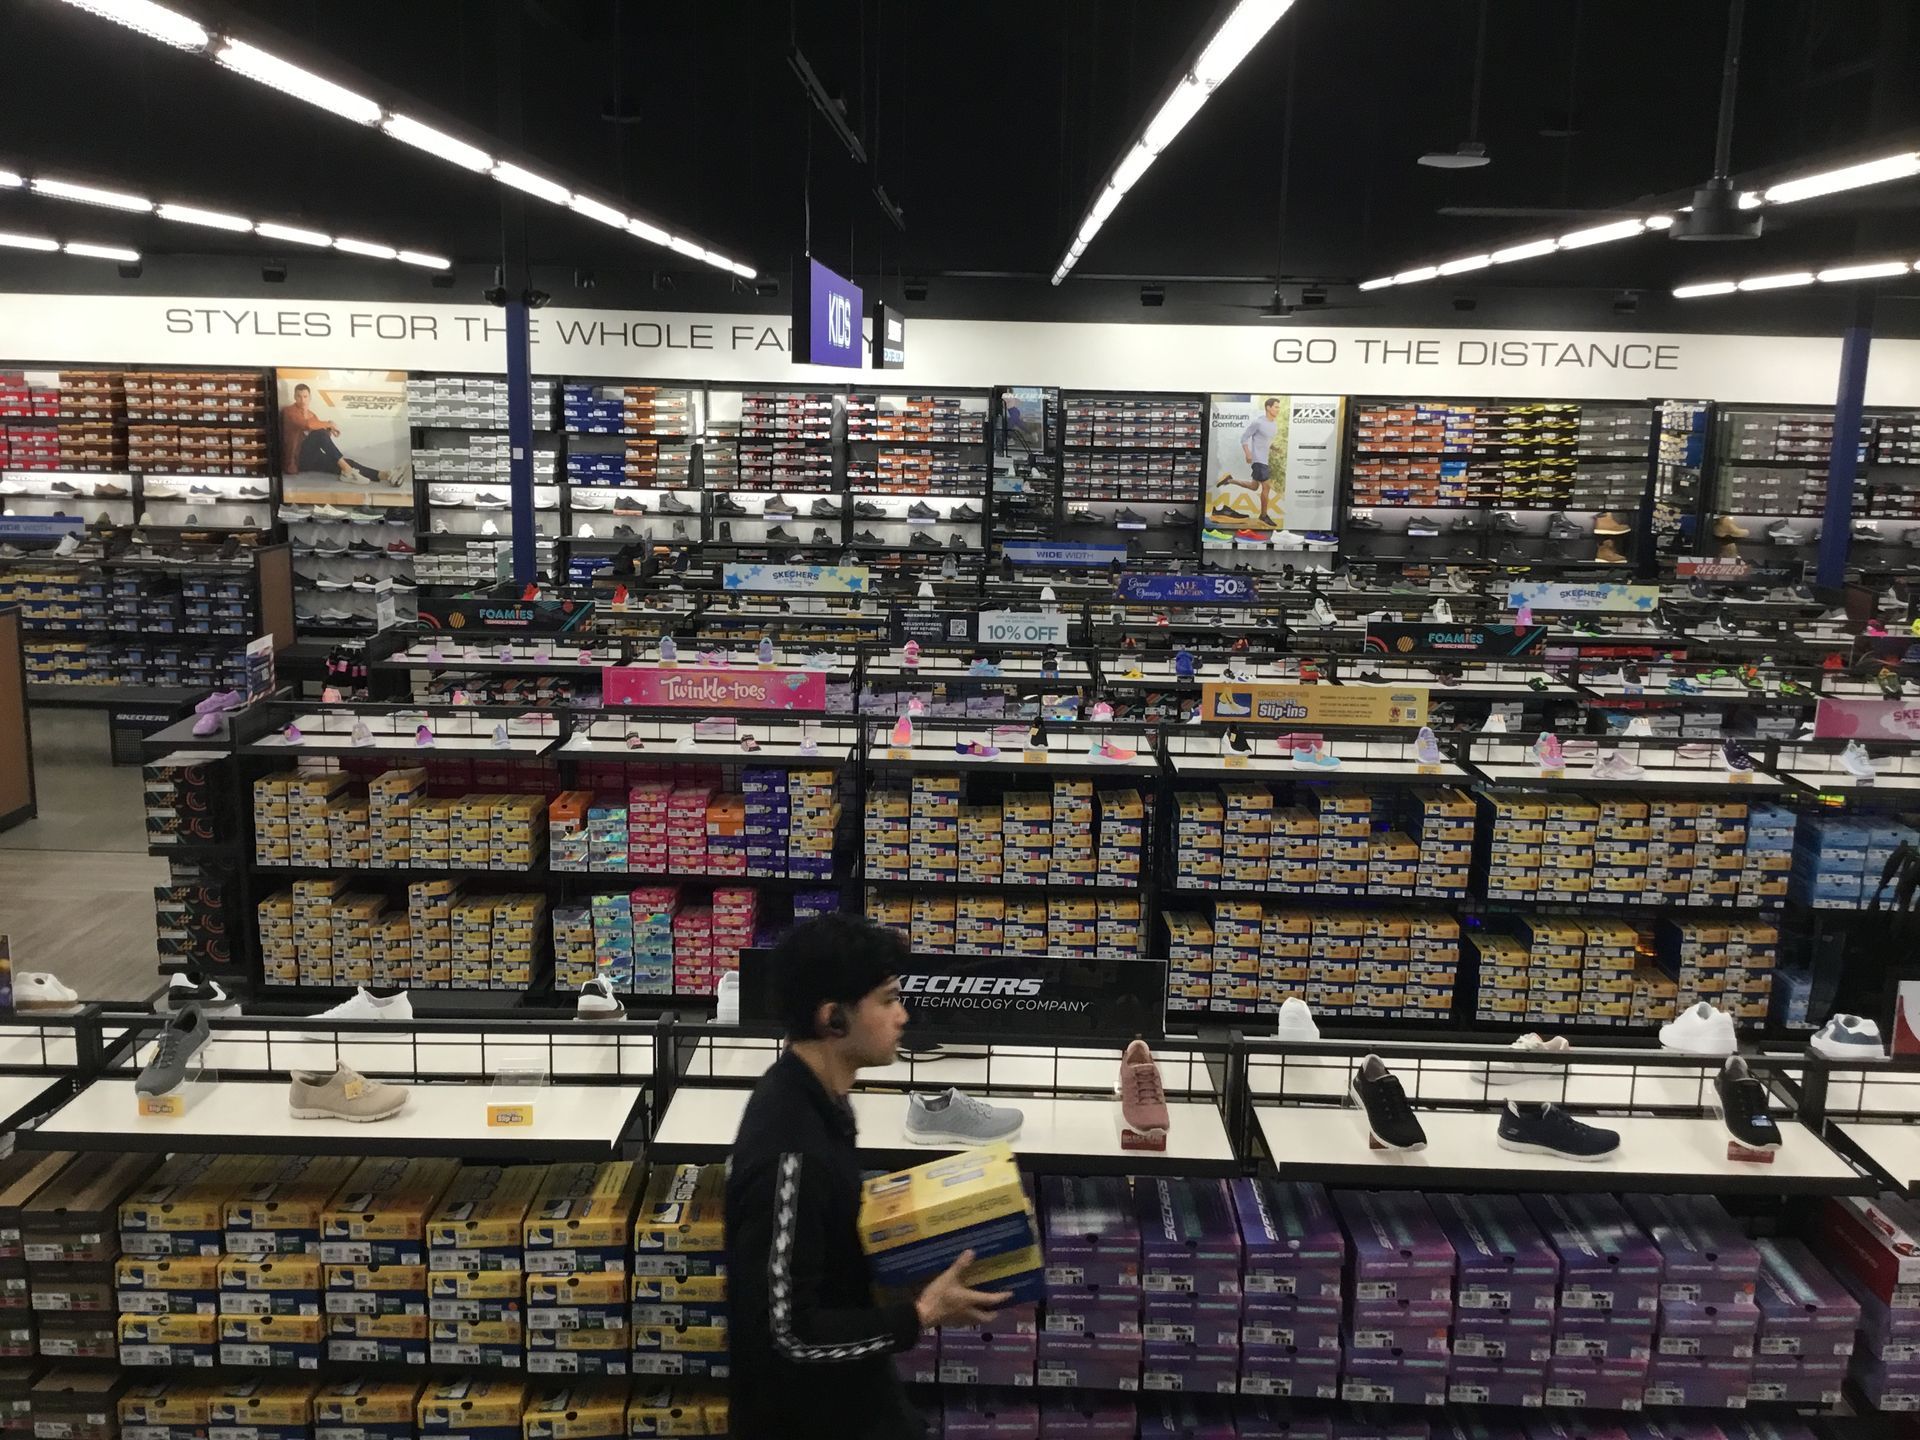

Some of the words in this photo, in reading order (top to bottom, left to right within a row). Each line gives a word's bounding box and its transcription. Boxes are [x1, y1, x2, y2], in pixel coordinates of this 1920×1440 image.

[828, 290, 851, 349] KIDS
[165, 308, 332, 338] STYLES
[350, 313, 438, 341] FOR
[556, 319, 713, 350] WHOLE
[1272, 338, 1337, 364] GO
[1354, 339, 1441, 365] THE
[1457, 341, 1680, 370] DISTANCE
[345, 402, 398, 410] SPORT
[1293, 409, 1336, 418] MAX
[1212, 420, 1245, 428] Comfort.
[1036, 551, 1063, 559] WIDE
[772, 570, 820, 581] SKECHERS
[1693, 564, 1749, 576] SKECHERS
[1174, 581, 1197, 590] SALE
[1213, 579, 1246, 595] 50%
[1559, 588, 1608, 600] SKECHERS
[479, 606, 534, 620] FOAMIES
[987, 624, 1021, 640] 10%
[1024, 626, 1059, 641] OFF
[1428, 630, 1484, 644] FOAMIES
[660, 675, 727, 702] Twinkle
[728, 681, 767, 701] toes
[115, 713, 170, 722] SKECHERS
[1258, 705, 1308, 720] Slip-ins
[913, 996, 1012, 1010] TECHNOLOGY
[1015, 999, 1090, 1013] COMPANY
[1156, 1179, 1179, 1242] SKECHERS
